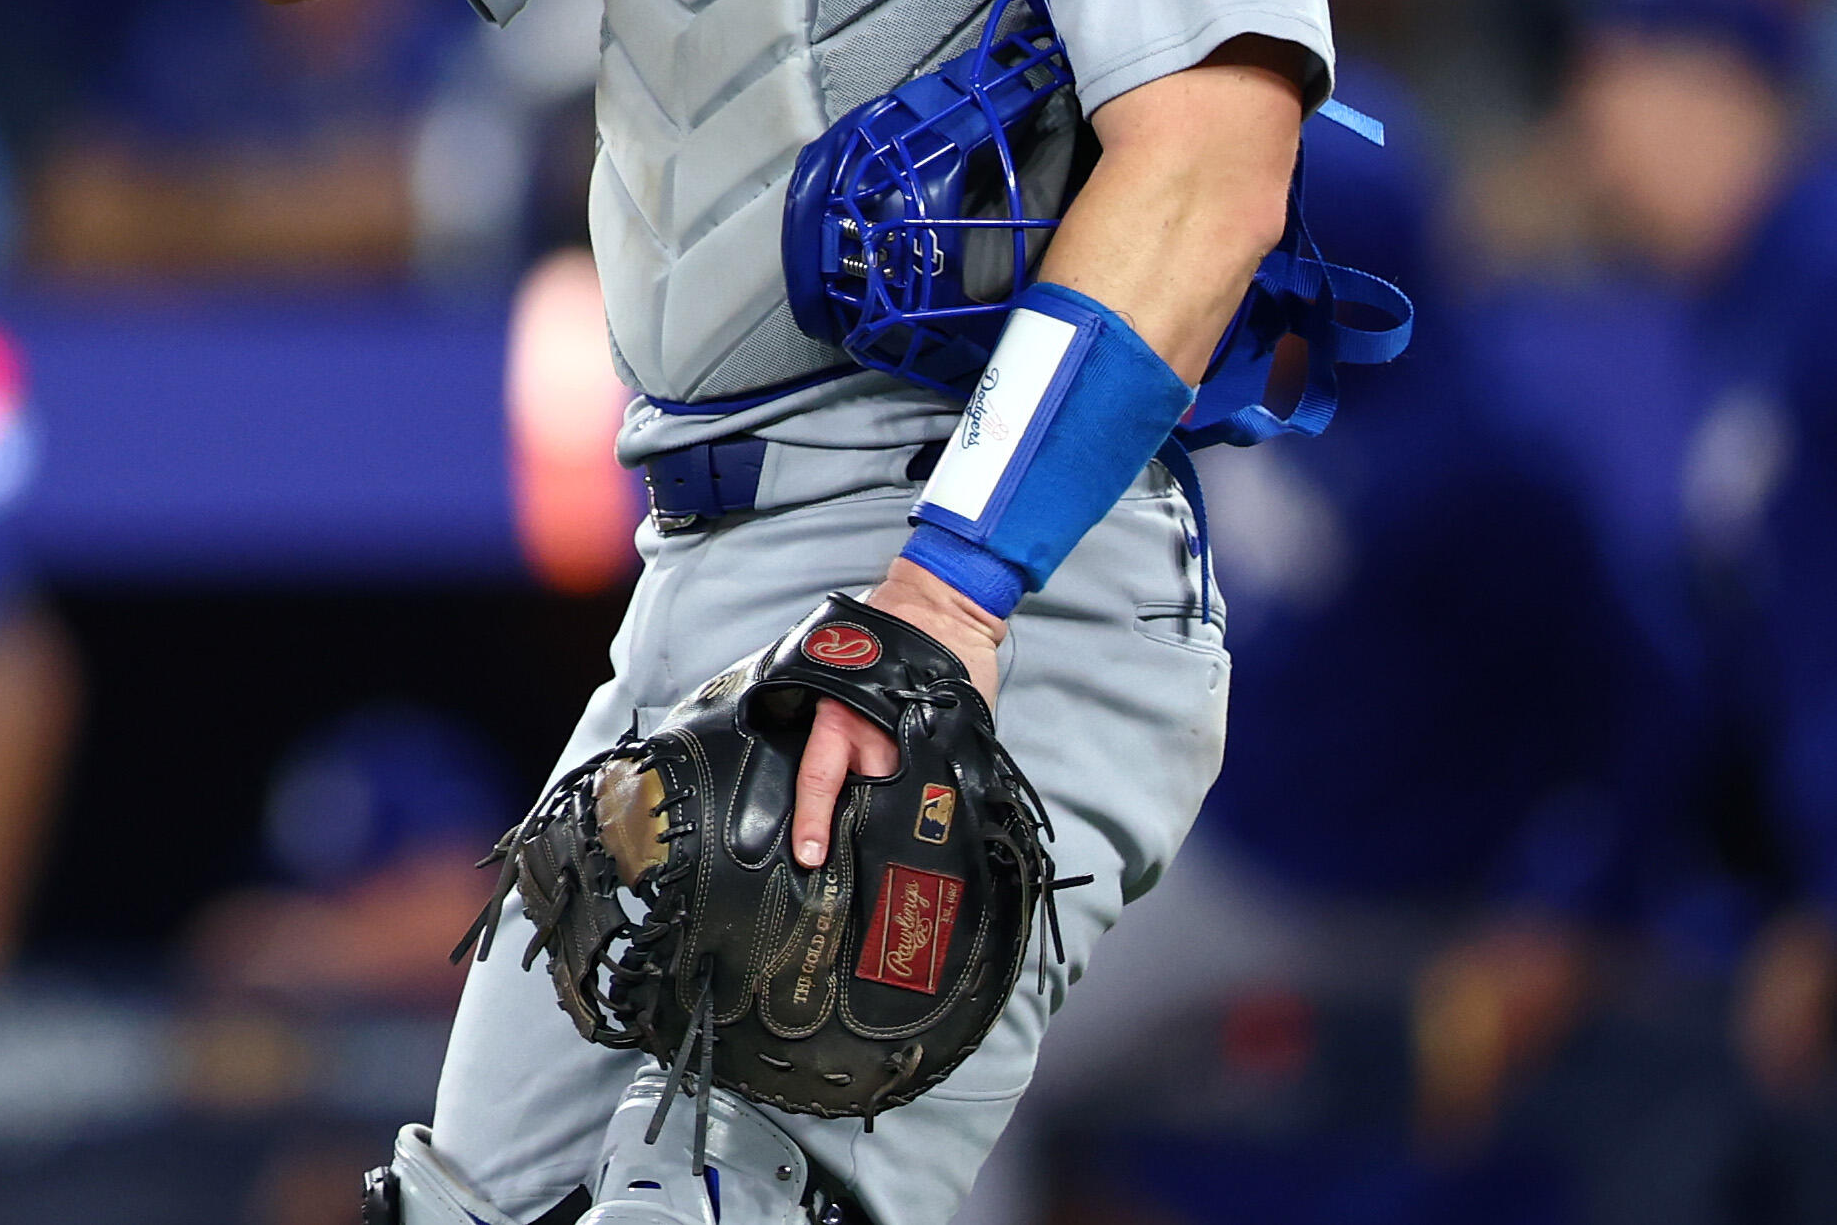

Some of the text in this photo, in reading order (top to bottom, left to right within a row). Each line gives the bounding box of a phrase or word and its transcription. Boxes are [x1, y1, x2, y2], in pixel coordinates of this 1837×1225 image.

[962, 367, 1000, 449] Dodgers
[802, 934, 825, 973] GOLD
[886, 880, 930, 977] Rawlings
[794, 976, 813, 1005] THE
